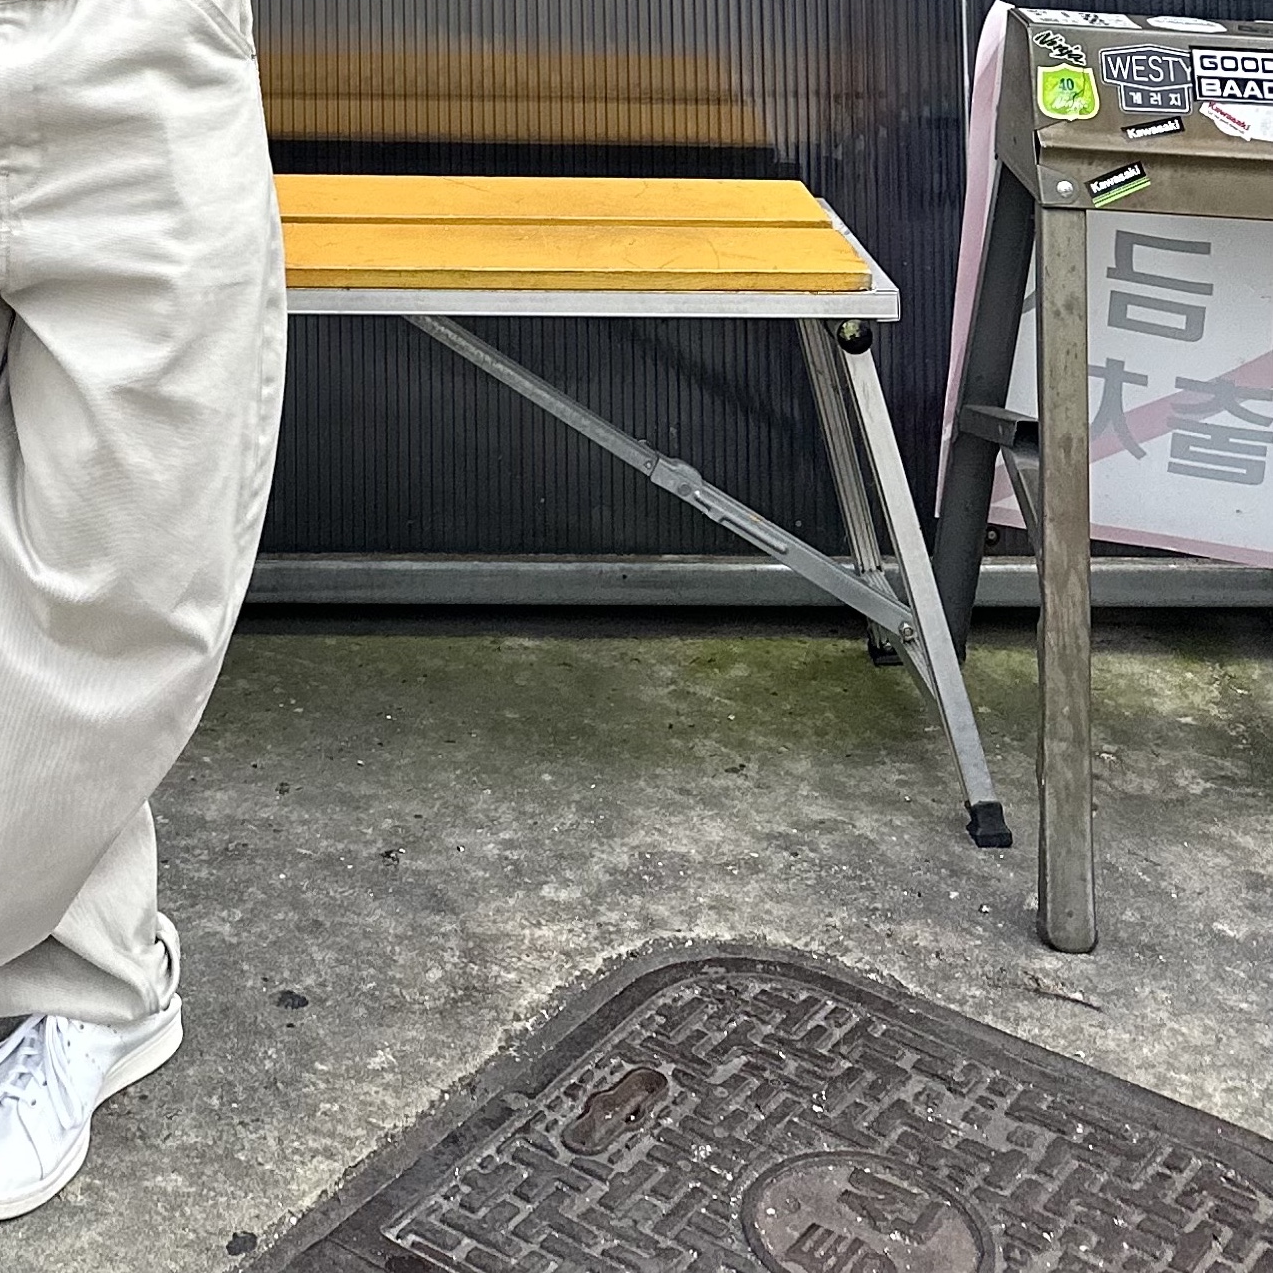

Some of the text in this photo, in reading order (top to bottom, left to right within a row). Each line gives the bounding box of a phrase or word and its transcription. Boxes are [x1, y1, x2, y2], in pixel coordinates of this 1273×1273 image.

[1107, 55, 1191, 82] WESTY
[1126, 118, 1180, 139] Kawasaki
[1089, 164, 1141, 194] Kawasaki
